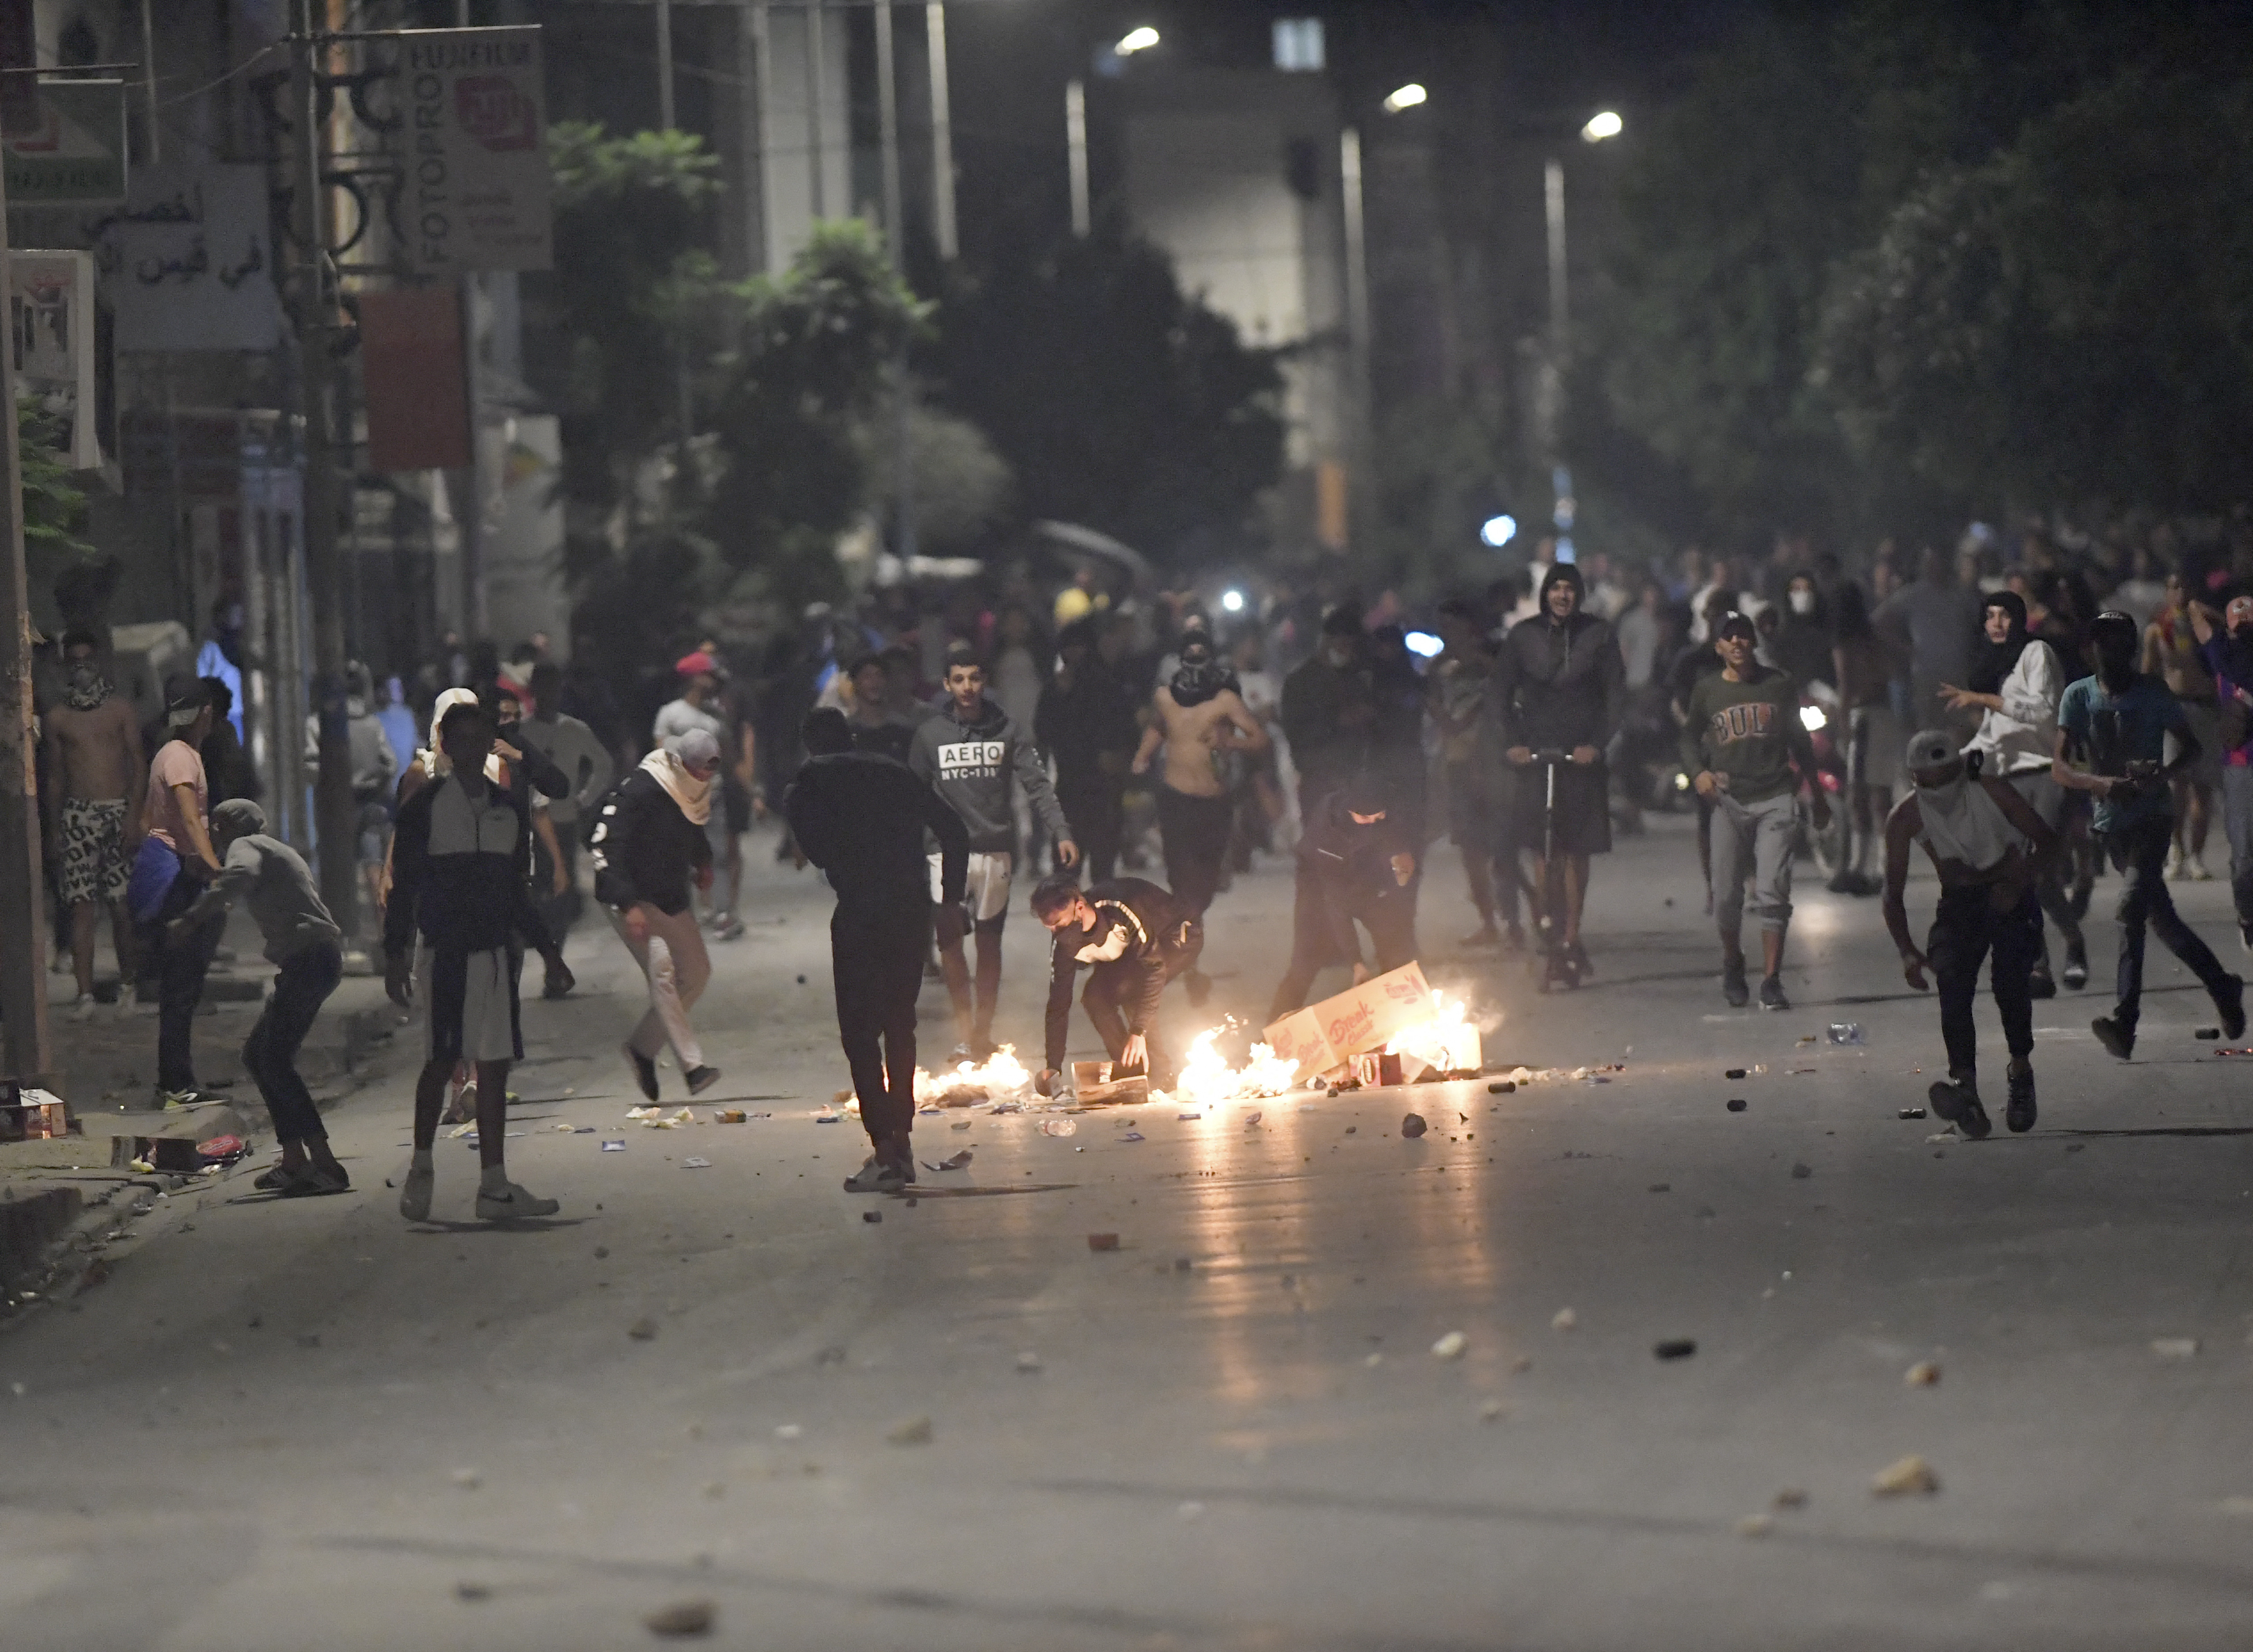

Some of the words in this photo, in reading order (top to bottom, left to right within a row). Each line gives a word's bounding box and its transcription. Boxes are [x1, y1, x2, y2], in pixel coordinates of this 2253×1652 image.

[413, 73, 450, 263] FOTOPRO
[945, 745, 1000, 763] AERO
[1329, 1001, 1375, 1045] Break
